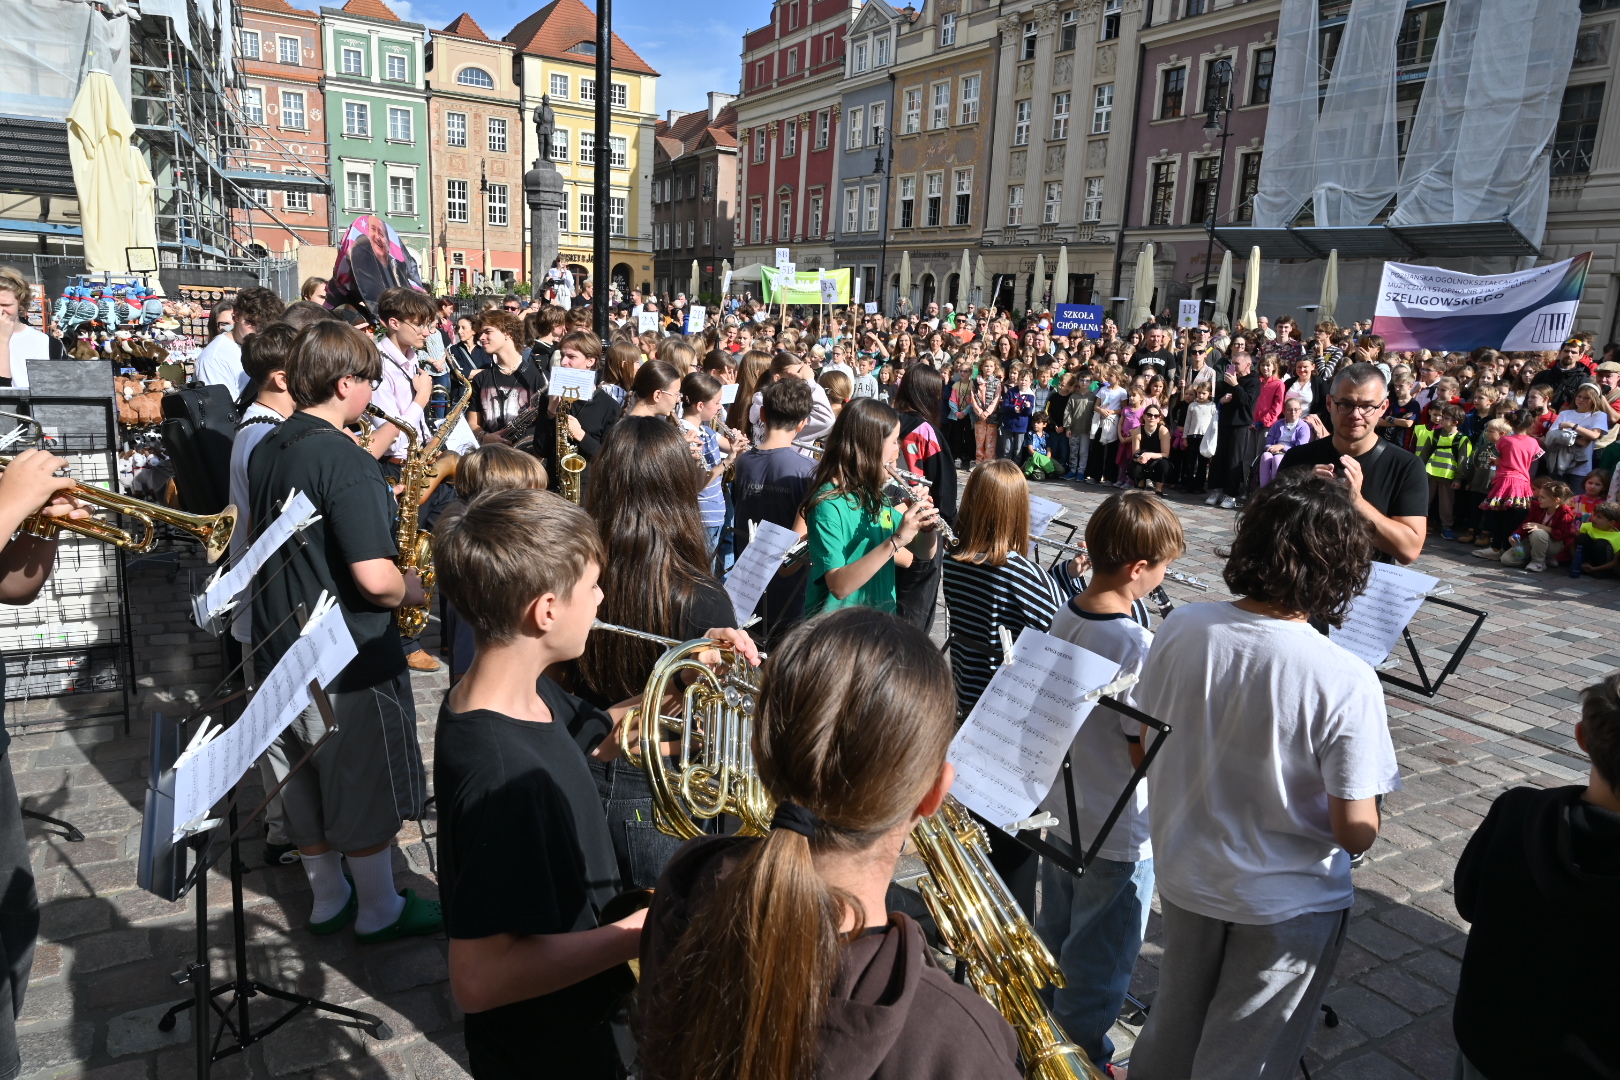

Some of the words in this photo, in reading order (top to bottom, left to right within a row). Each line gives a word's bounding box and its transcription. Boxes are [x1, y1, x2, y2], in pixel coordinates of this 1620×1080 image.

[777, 250, 788, 258] 8B
[919, 251, 931, 259] town
[931, 250, 949, 260] vintage
[781, 266, 794, 275] 5B
[1390, 271, 1434, 282] POZNAŃSKA
[822, 282, 836, 292] 3A
[1387, 282, 1427, 292] MUZYCZNA
[1385, 292, 1505, 306] SZELIGOWSKIEGO
[692, 309, 704, 319] 2B
[1182, 304, 1197, 314] 1B
[1062, 310, 1095, 320] SZKOŁA
[641, 315, 656, 326] 2A
[1056, 321, 1099, 332] CHÓRALNA
